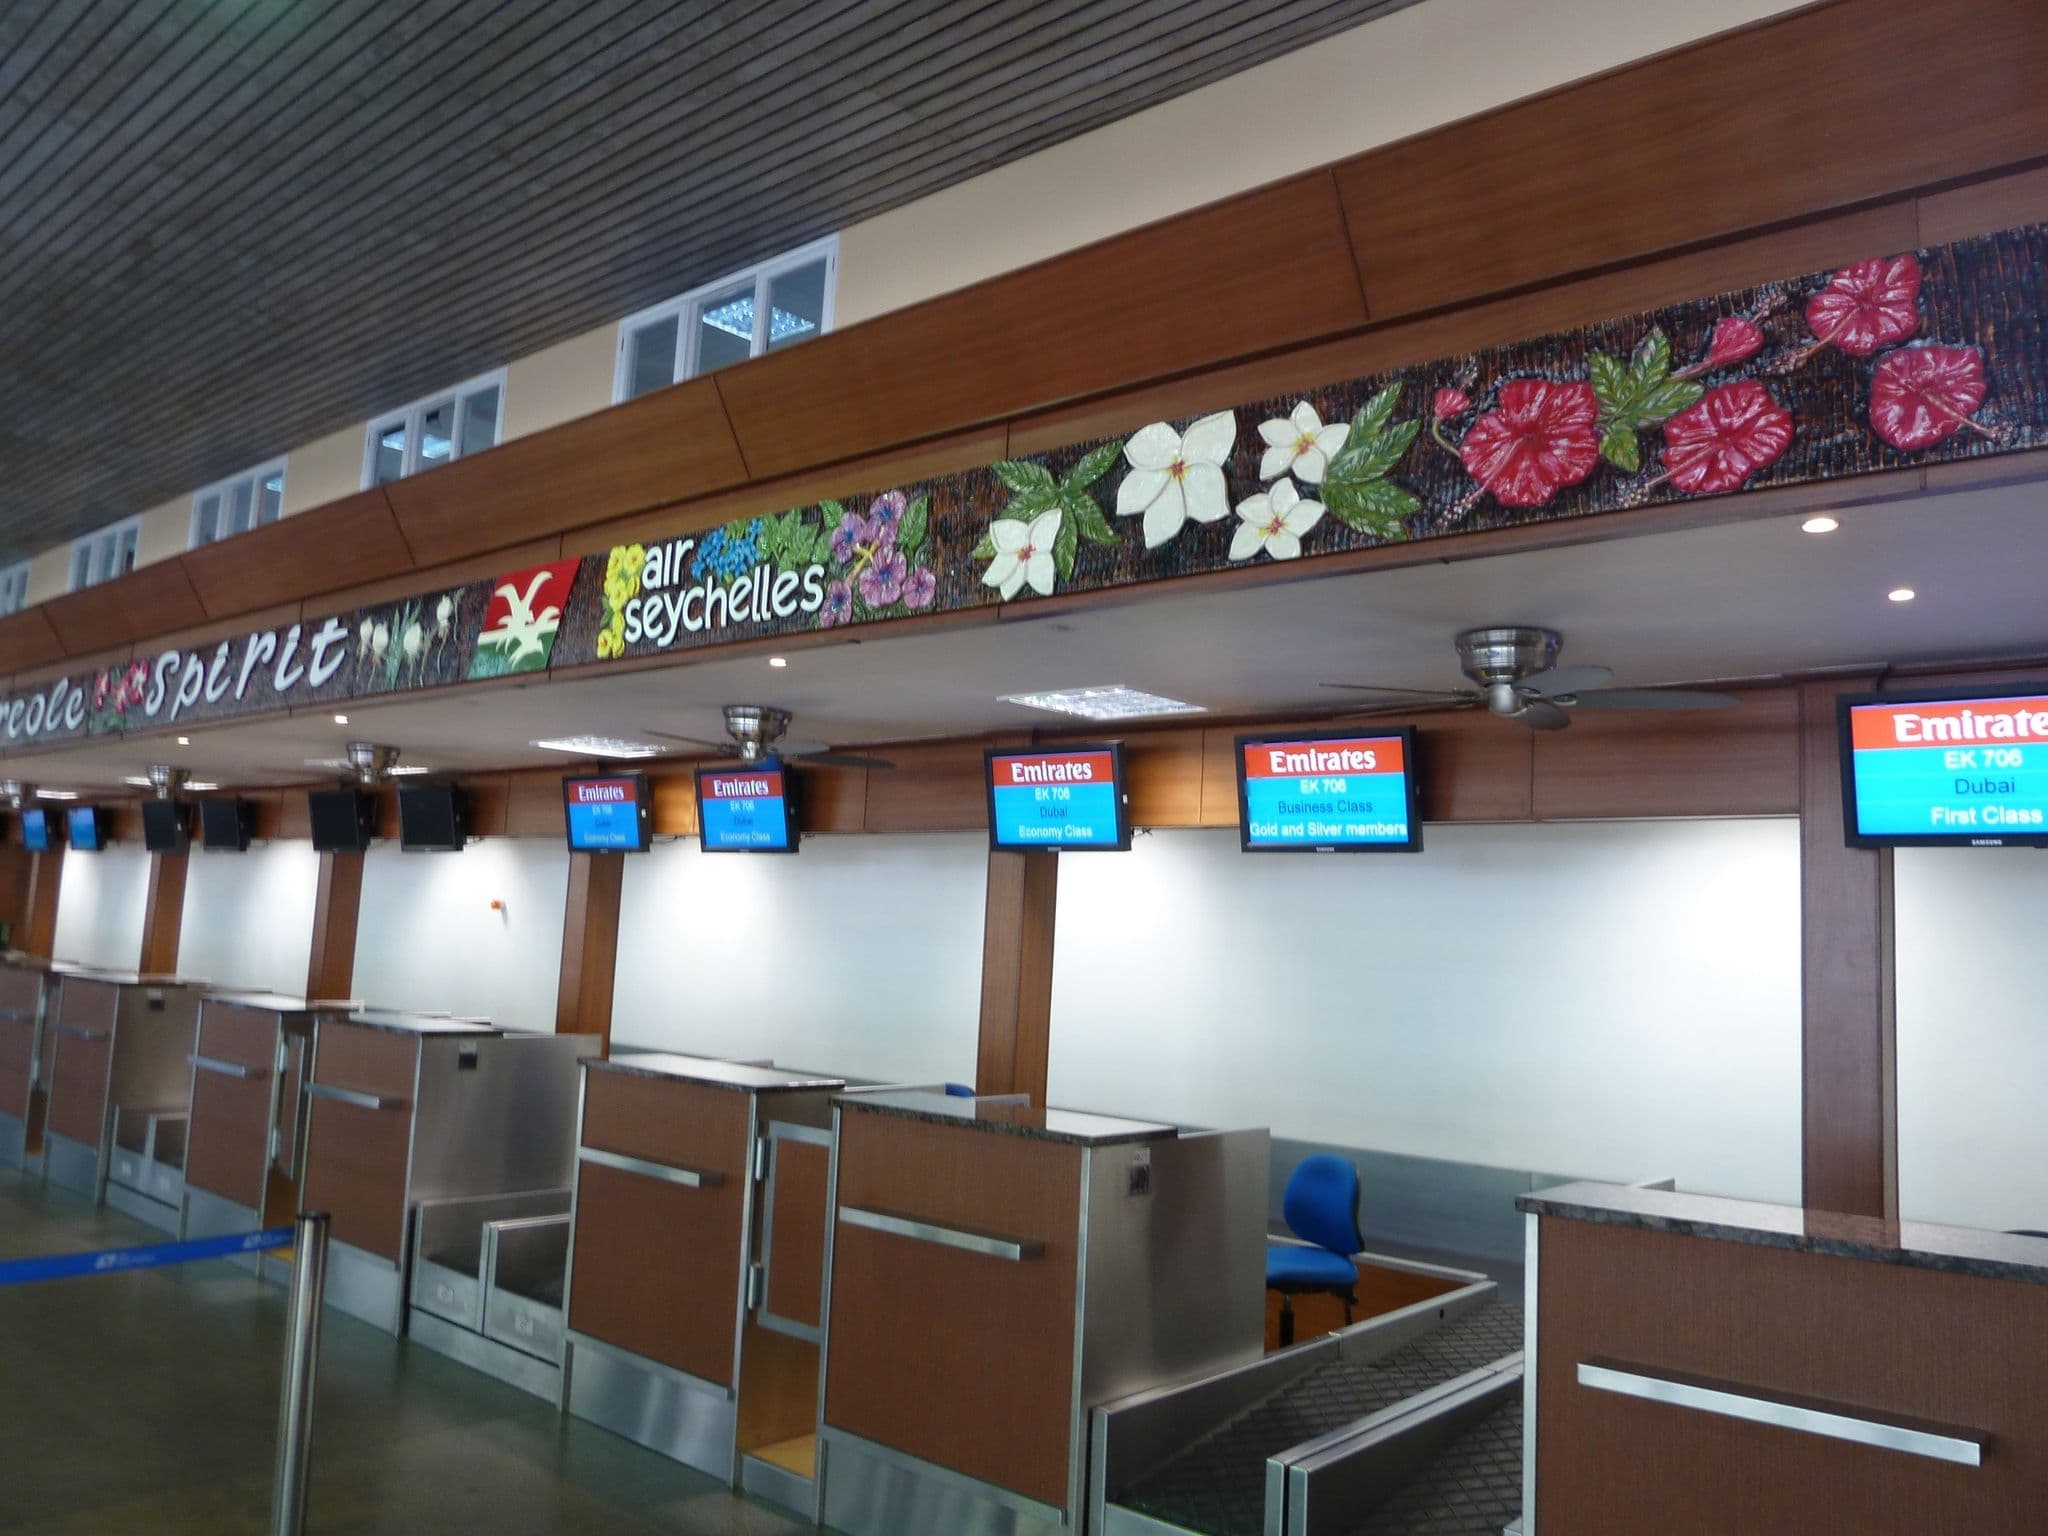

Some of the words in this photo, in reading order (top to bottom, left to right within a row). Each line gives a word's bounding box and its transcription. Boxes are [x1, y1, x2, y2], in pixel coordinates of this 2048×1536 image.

[642, 539, 694, 590] air
[624, 563, 825, 648] seychelles
[1269, 748, 1376, 773] Emirates
[1945, 749, 1977, 769] EK
[1982, 748, 2023, 768] 706
[1010, 760, 1092, 782] Emirates
[578, 784, 624, 802] Emirates
[713, 778, 769, 797] Emirates
[1034, 788, 1049, 801] EK
[1300, 779, 1320, 794] EK
[1323, 778, 1346, 793] 706
[1955, 777, 2016, 795] Dubai
[1040, 806, 1068, 818] Dubai
[1278, 800, 1333, 815] Business
[1337, 800, 1373, 813] Class
[1931, 806, 1977, 825] First
[1982, 805, 2043, 825] Class
[1019, 825, 1063, 840] Economy
[1065, 824, 1093, 838] Class
[1250, 822, 1278, 837] Gold
[1281, 822, 1304, 837] and
[1308, 822, 1343, 837] Silver
[1346, 822, 1408, 836] members
